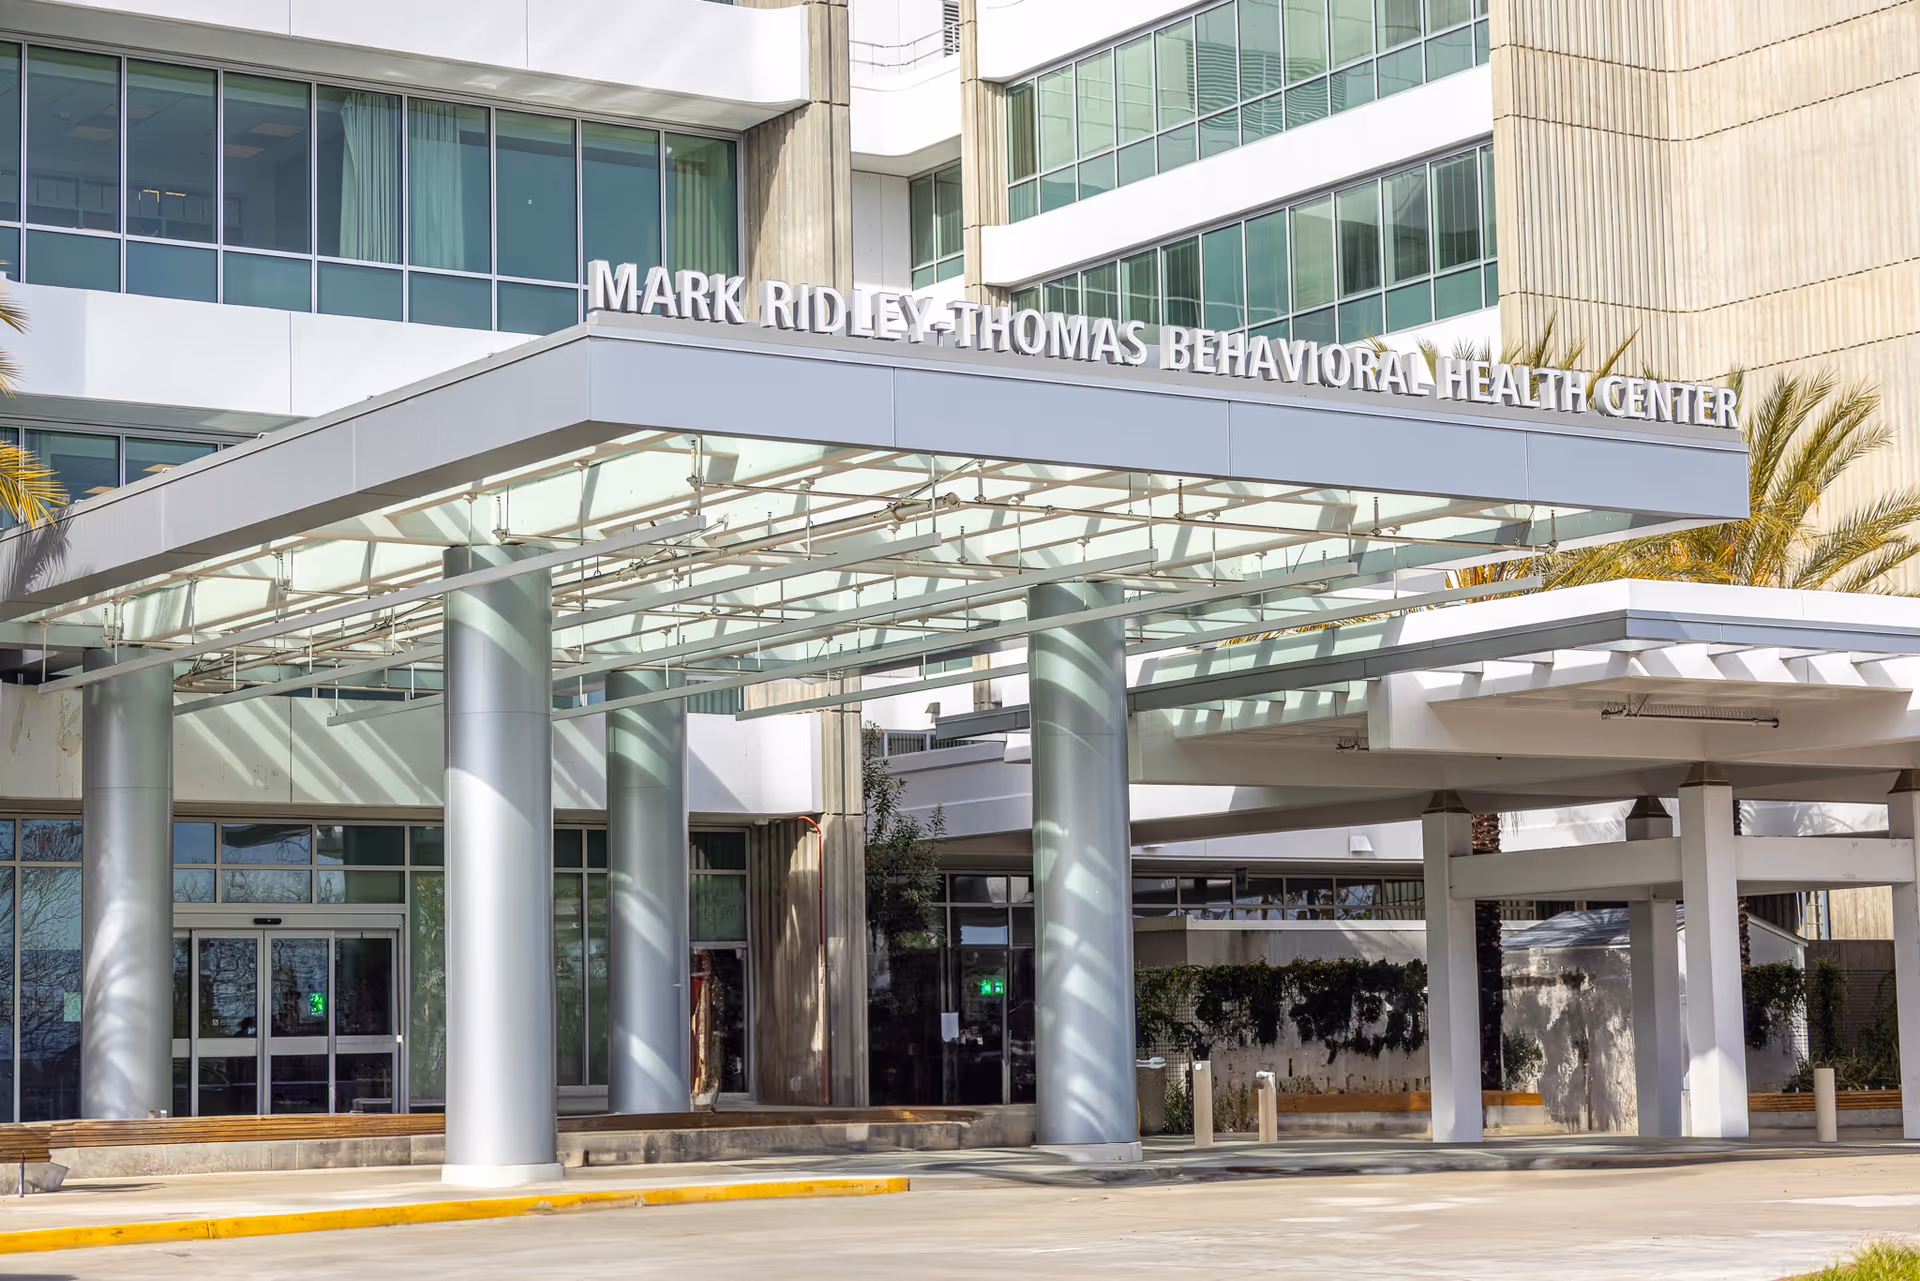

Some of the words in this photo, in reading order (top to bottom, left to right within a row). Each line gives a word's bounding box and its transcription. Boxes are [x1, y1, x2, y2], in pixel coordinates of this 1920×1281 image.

[587, 260, 747, 324] MARK
[761, 280, 1148, 366] RIDLEY-THOMAS
[1159, 325, 1430, 396] BEHAVIORAL
[1436, 356, 1587, 413] HEALTH
[1594, 374, 1740, 429] CENTER
